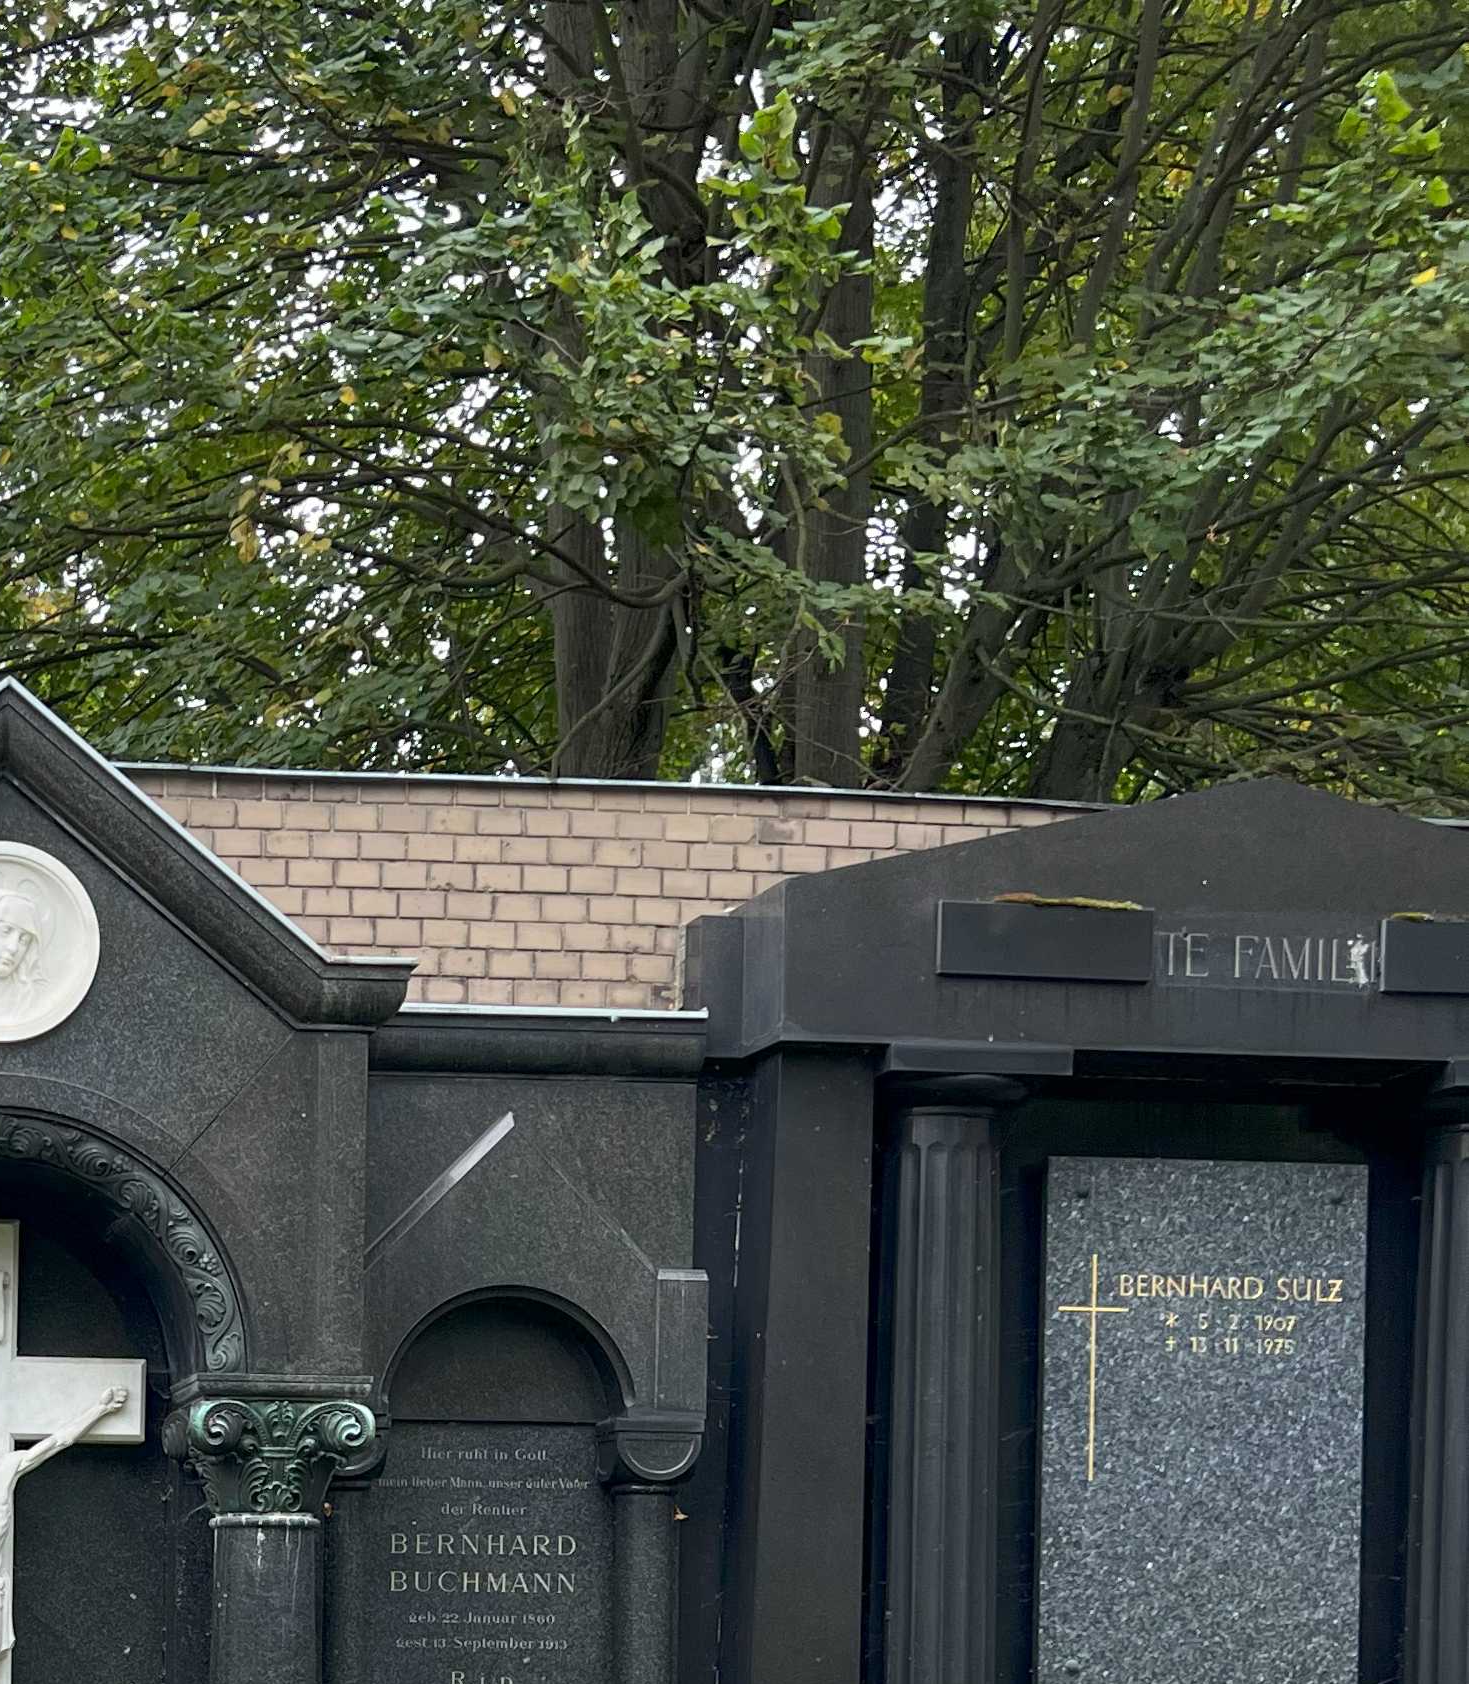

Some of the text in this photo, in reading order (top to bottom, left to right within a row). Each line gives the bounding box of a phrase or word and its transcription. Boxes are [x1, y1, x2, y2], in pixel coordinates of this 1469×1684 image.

[1119, 1274, 1344, 1303] BERNHARD SULZ
[1254, 1314, 1298, 1331] 1907
[1256, 1338, 1296, 1355] 1975
[421, 1448, 548, 1461] Hier ruht in Gott
[378, 1477, 408, 1488] mein
[412, 1477, 448, 1489] lieber
[488, 1478, 523, 1489] unser
[525, 1478, 556, 1490] guter
[558, 1478, 592, 1490] Vater
[441, 1503, 527, 1516] der Rentier
[390, 1533, 577, 1556] BERNHARD
[389, 1570, 577, 1594] BUCHMANN
[464, 1611, 518, 1625] Januar
[454, 1636, 534, 1652] September
